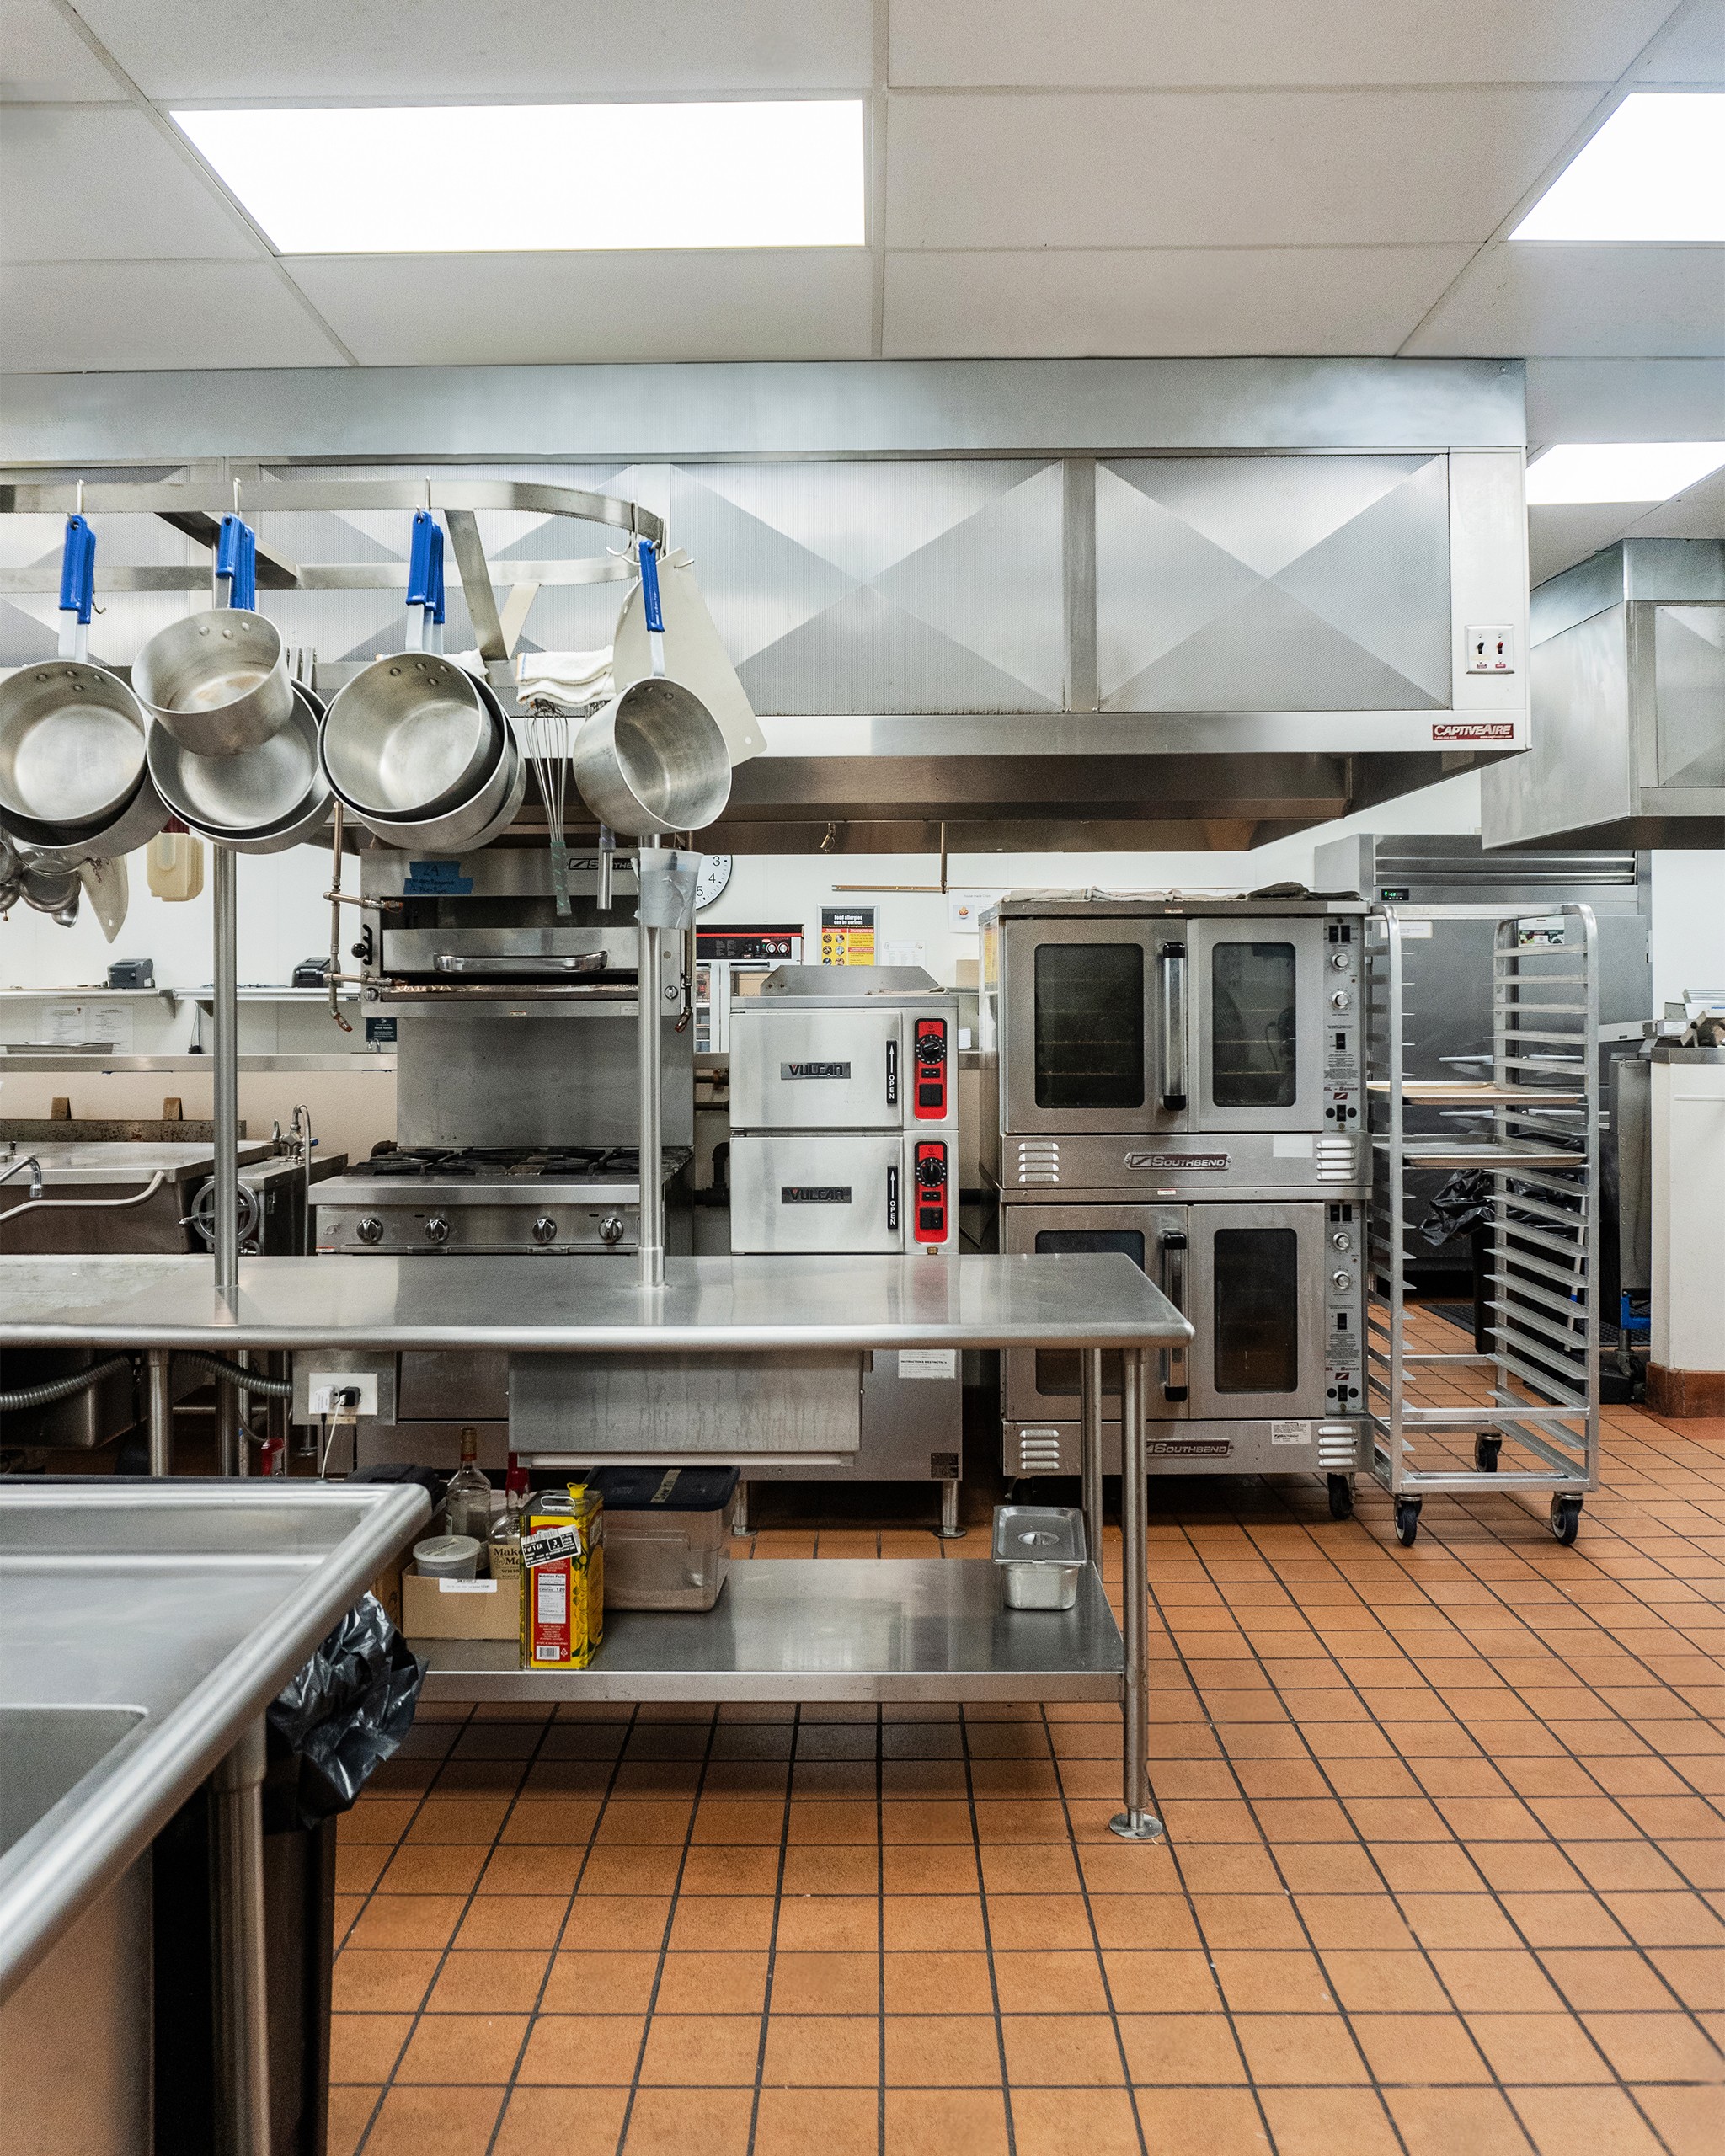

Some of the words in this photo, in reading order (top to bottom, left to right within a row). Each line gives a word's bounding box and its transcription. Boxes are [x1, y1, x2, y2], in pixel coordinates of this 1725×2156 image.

[713, 855, 721, 867] 3
[708, 873, 716, 883] 4
[696, 886, 704, 896] 5
[788, 1065, 843, 1075] VULCAN
[789, 1189, 844, 1200] VULCAN
